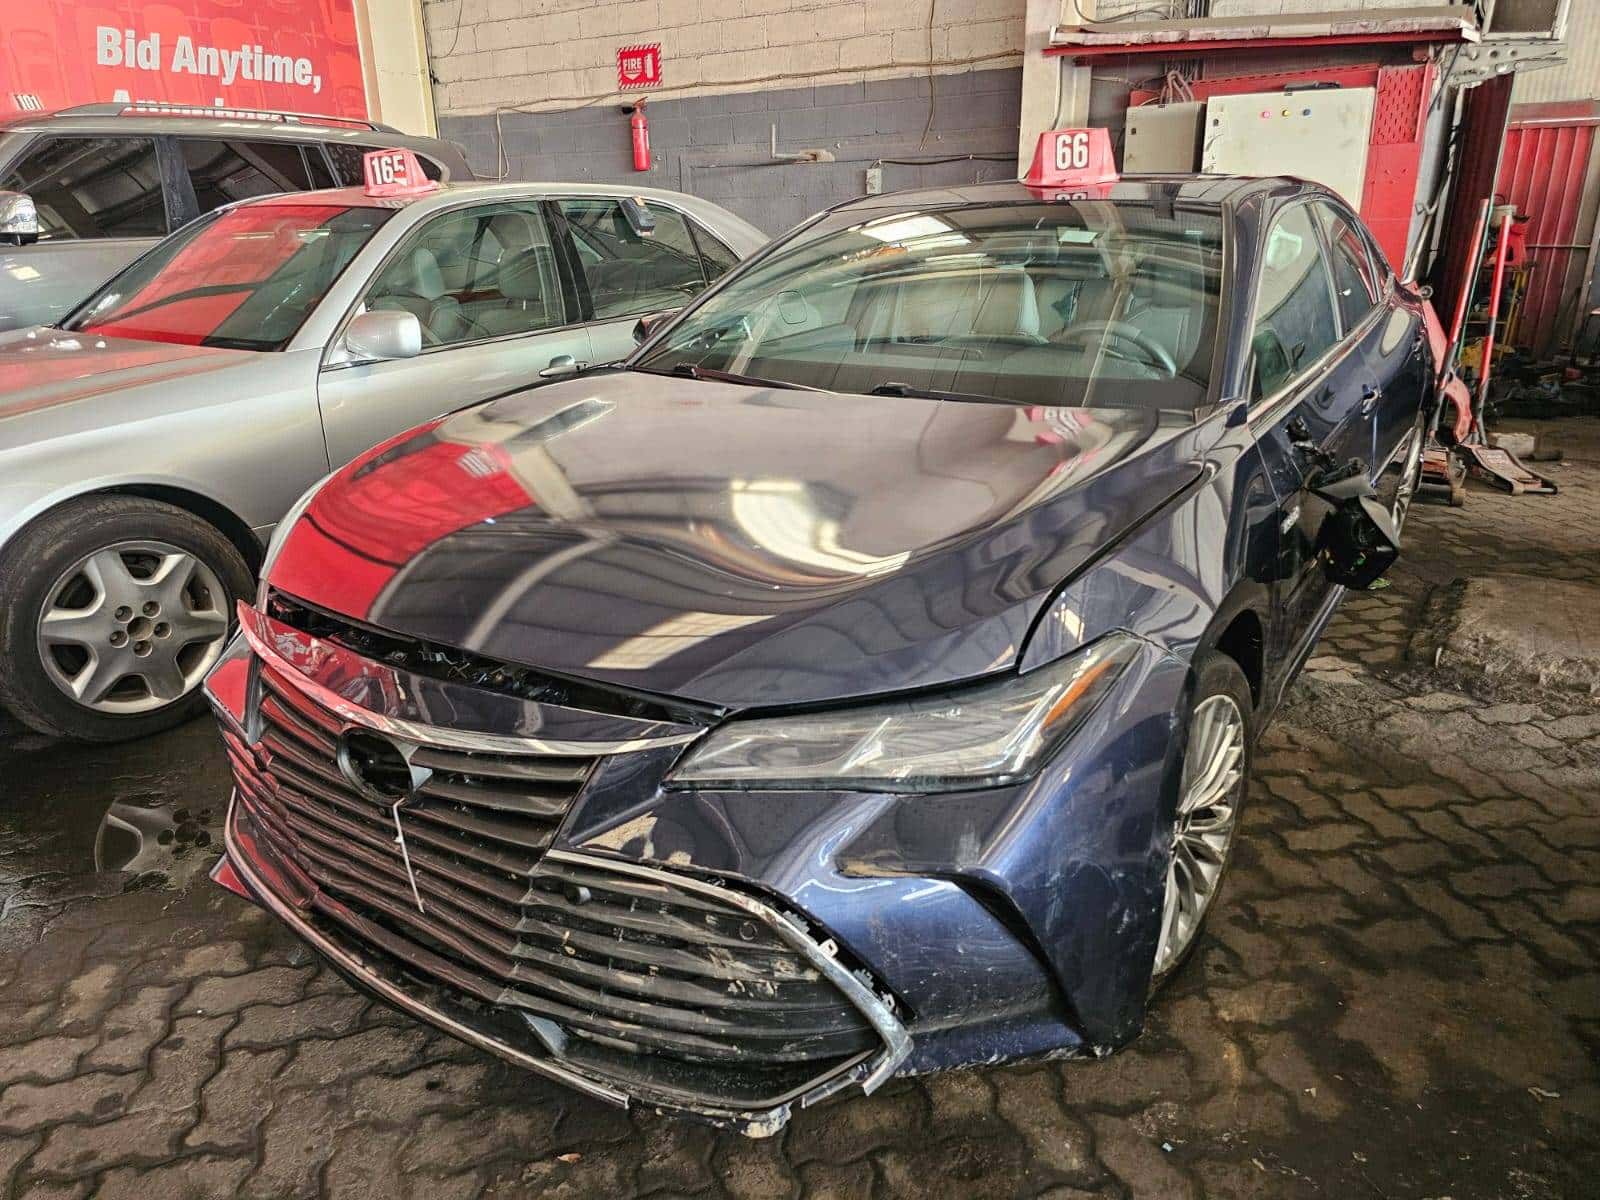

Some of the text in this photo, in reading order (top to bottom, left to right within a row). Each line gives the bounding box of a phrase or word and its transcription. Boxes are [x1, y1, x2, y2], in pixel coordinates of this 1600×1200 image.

[96, 26, 321, 94] Bid Anytime,
[622, 57, 642, 71] FIRE
[1056, 132, 1089, 170] 66
[371, 154, 408, 186] 165
